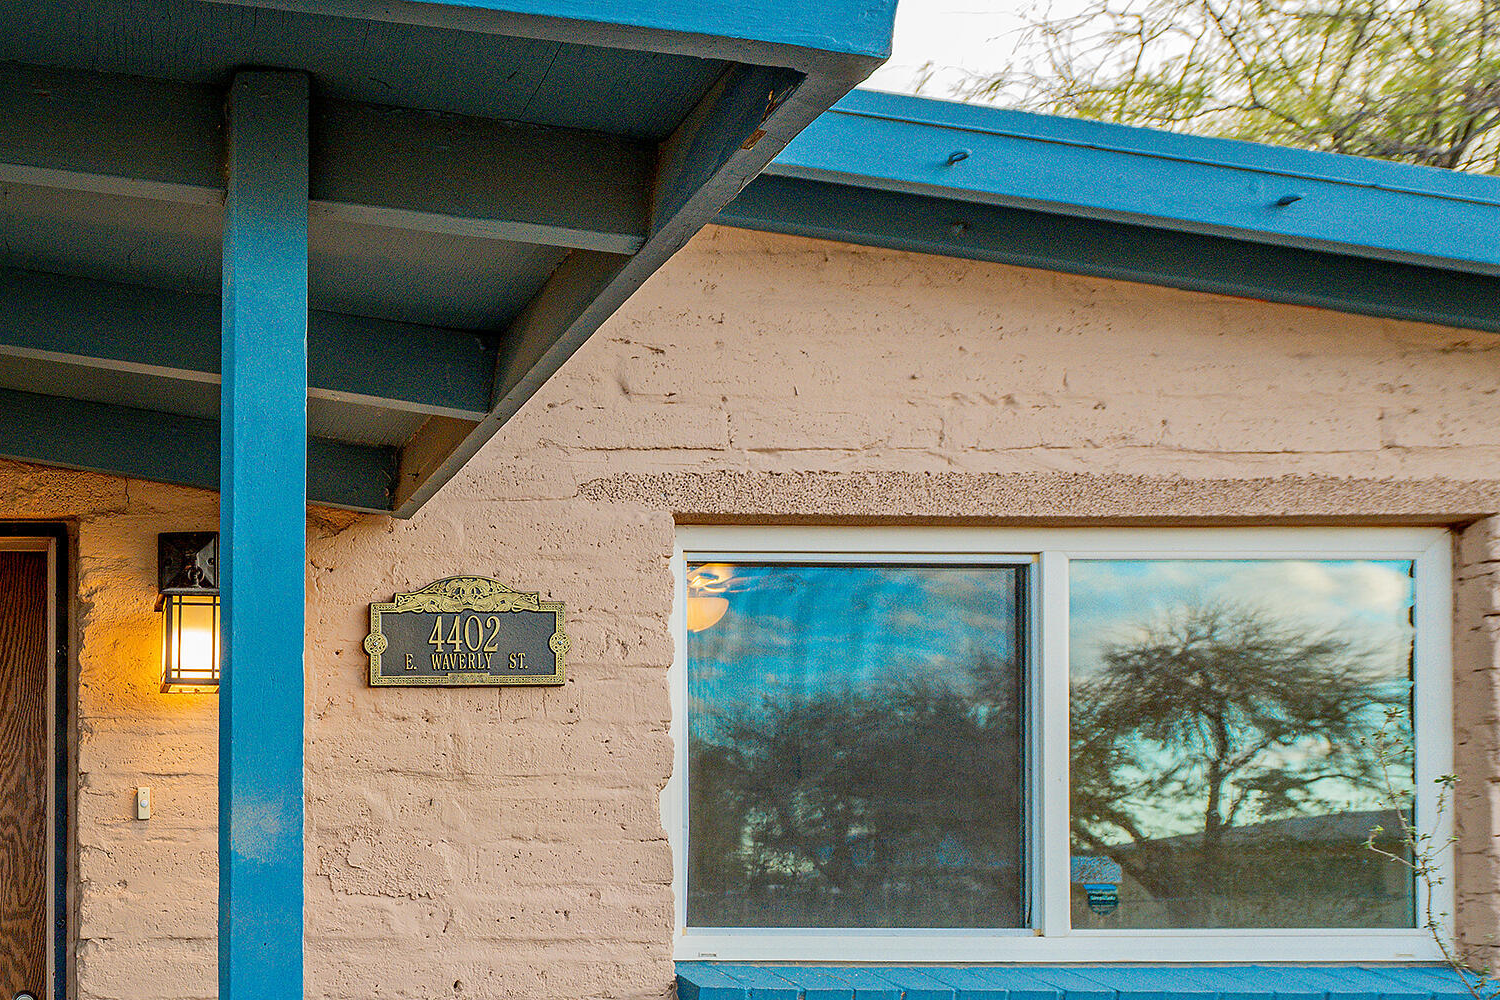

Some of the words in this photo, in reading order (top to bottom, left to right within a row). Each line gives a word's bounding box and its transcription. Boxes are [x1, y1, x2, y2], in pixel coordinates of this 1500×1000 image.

[428, 615, 501, 653] 4402
[405, 653, 417, 670] E.
[431, 652, 493, 670] WAVERLY
[508, 652, 529, 670] ST.
